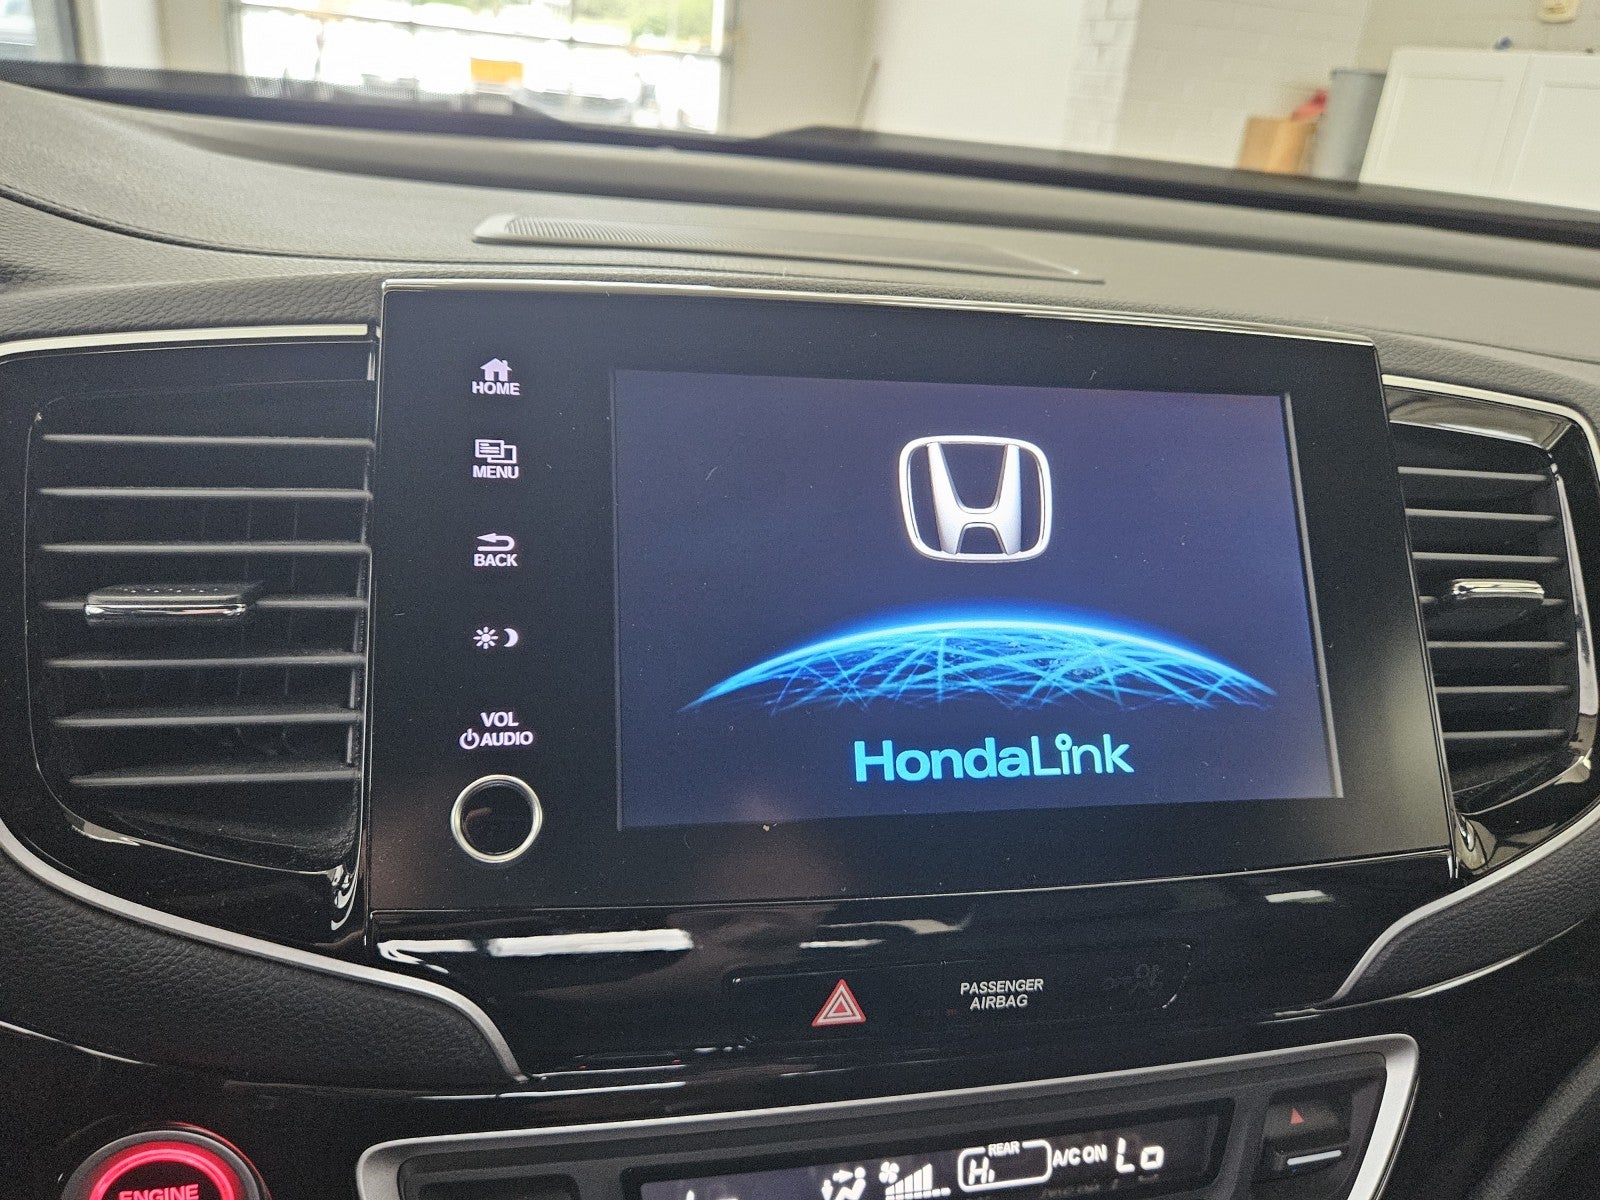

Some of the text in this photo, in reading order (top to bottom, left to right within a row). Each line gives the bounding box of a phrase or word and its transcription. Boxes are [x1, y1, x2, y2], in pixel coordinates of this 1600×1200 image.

[471, 381, 521, 396] HOME
[472, 464, 520, 479] MENU
[473, 553, 519, 567] BACK
[480, 711, 520, 728] VOL
[479, 730, 534, 747] AUDIO
[853, 732, 1136, 783] HondaLink
[959, 978, 1045, 996] PASSENGER
[969, 994, 1028, 1012] AIRBAG
[988, 1140, 1021, 1158] REAR
[1052, 1143, 1109, 1169] A/C ON
